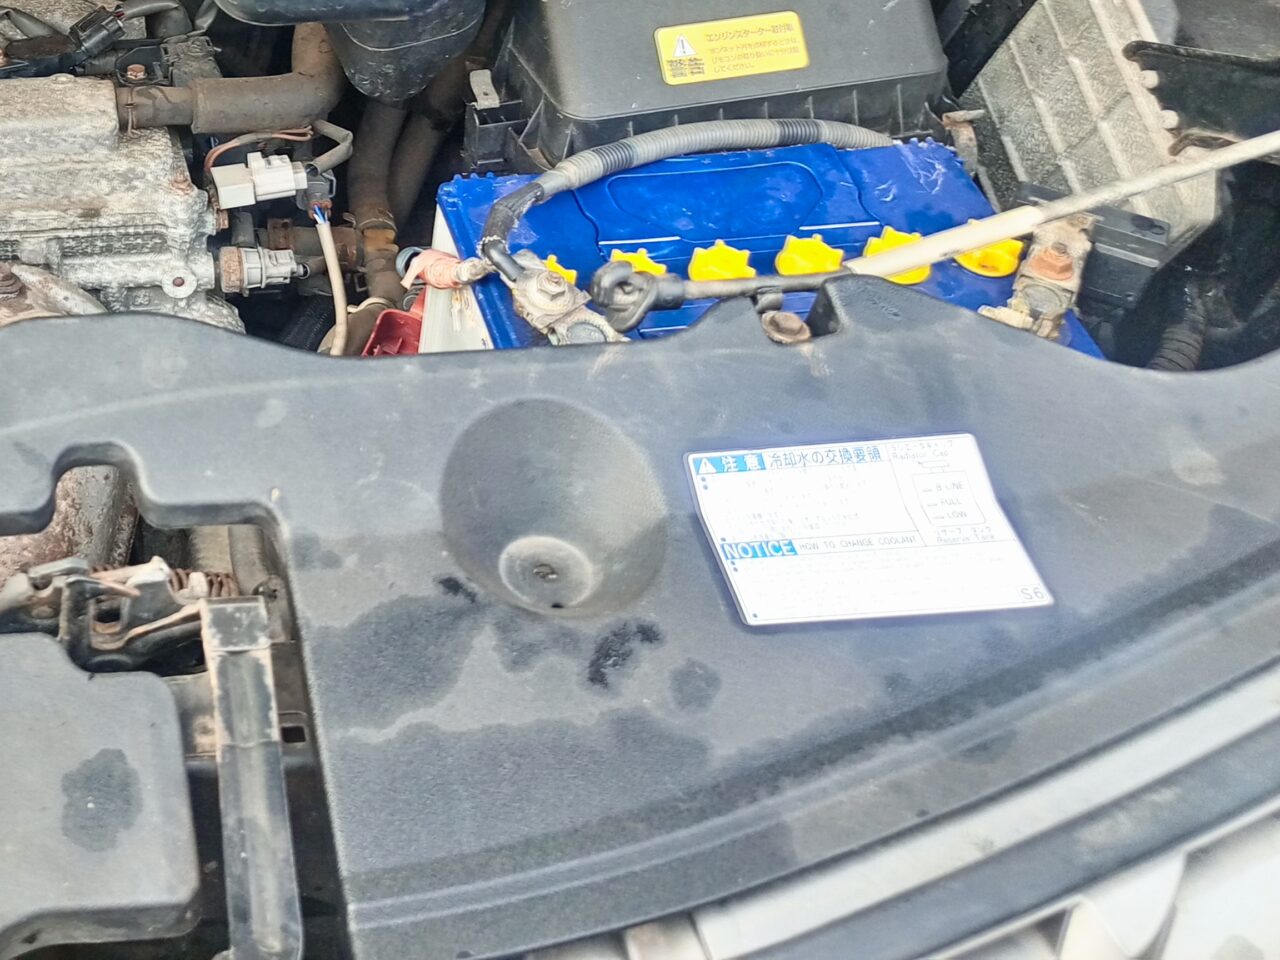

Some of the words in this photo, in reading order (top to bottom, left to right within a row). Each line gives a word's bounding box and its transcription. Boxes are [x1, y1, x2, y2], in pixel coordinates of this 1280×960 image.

[722, 452, 764, 472] 注意
[769, 445, 882, 469] 冷却水の交換要領
[723, 539, 795, 560] NOTICE
[824, 541, 836, 549] TO
[840, 539, 873, 548] CHANGE
[878, 535, 918, 546] COOLANT
